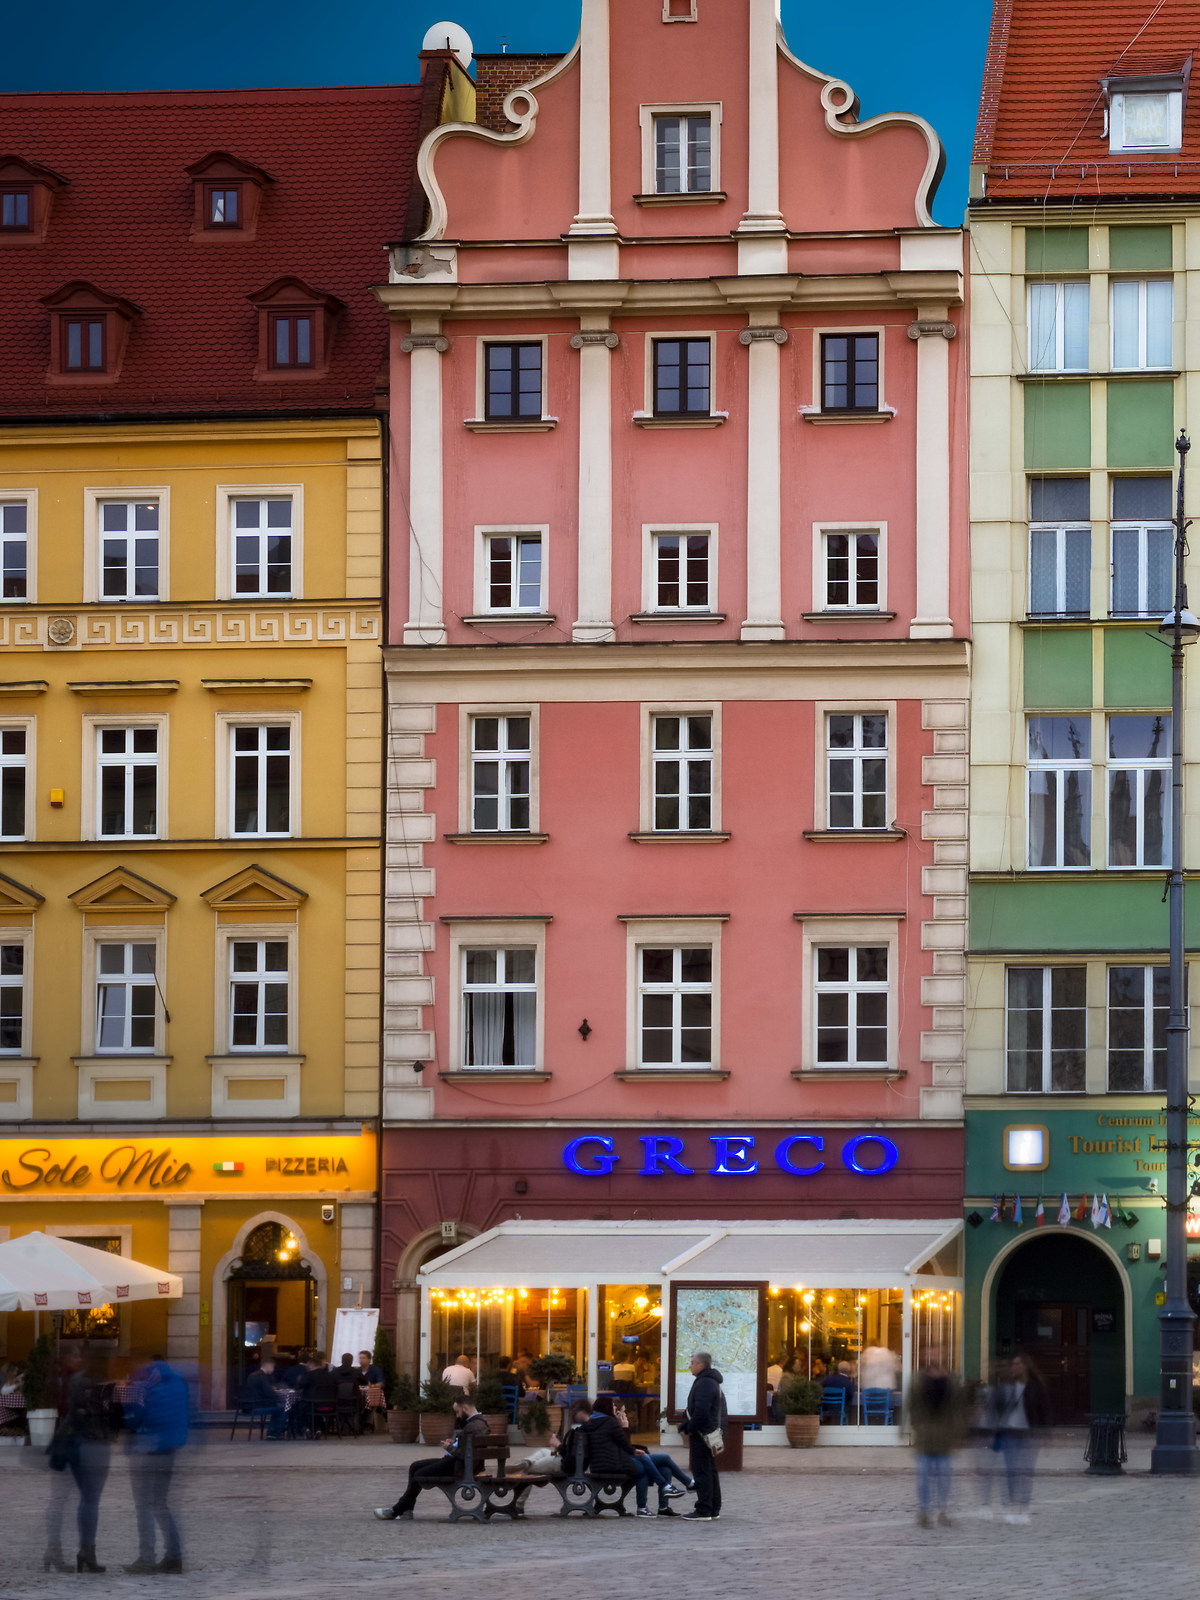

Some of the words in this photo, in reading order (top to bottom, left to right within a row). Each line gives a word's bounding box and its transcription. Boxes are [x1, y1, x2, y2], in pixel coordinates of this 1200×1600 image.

[1097, 1114, 1154, 1127] Centrum
[1068, 1135, 1141, 1154] Tourist
[562, 1134, 899, 1176] GRECO
[2, 1148, 92, 1189] Sole
[100, 1146, 193, 1189] Mio
[265, 1156, 348, 1176] PIZZERIA
